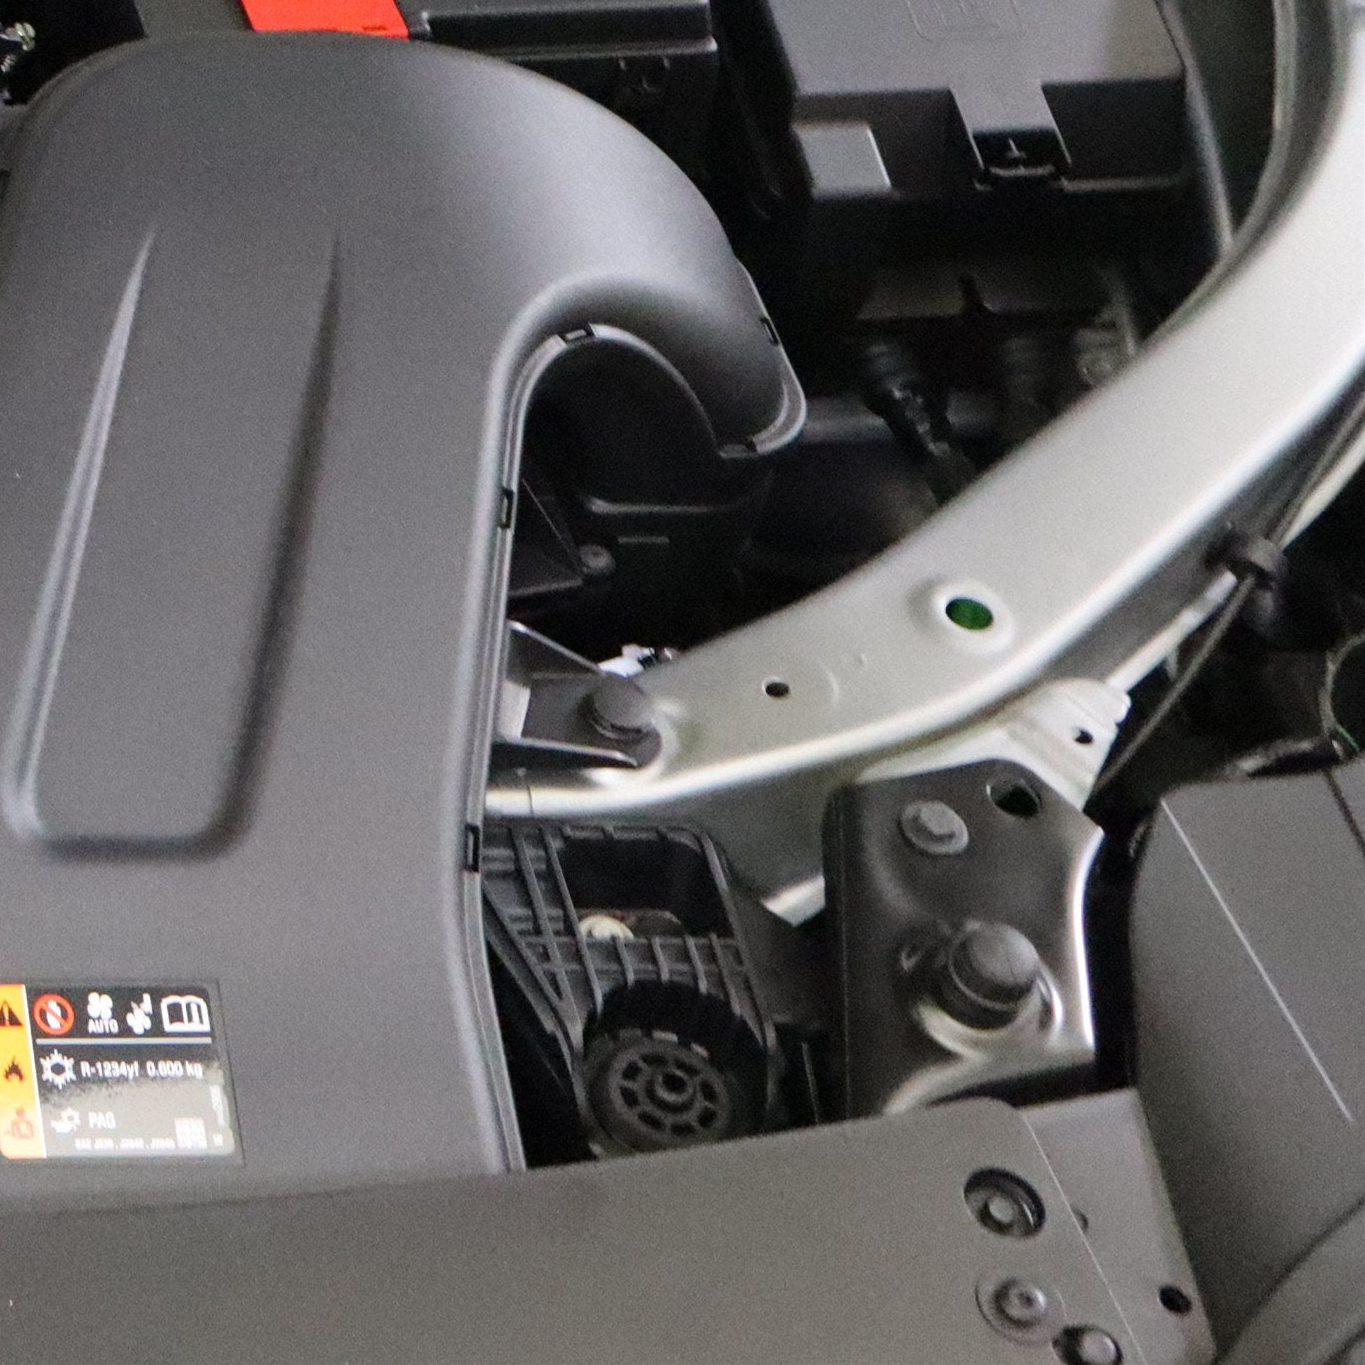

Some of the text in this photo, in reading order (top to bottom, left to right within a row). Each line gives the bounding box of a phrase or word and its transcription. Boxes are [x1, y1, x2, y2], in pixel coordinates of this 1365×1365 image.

[88, 1020, 118, 1033] AUTO
[81, 1061, 139, 1080] R-1234yf
[187, 1062, 202, 1078] kg
[89, 1113, 115, 1128] PAG
